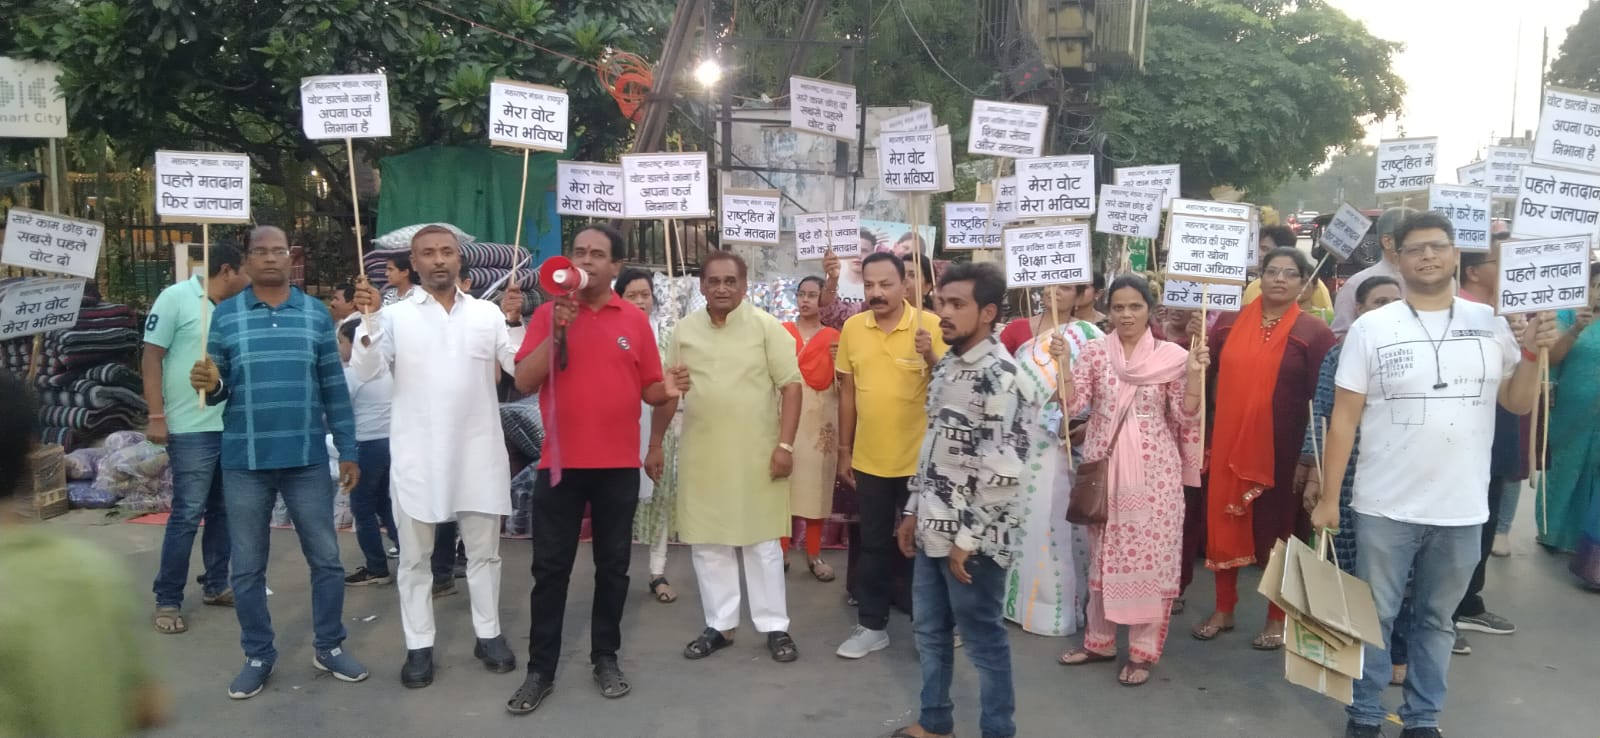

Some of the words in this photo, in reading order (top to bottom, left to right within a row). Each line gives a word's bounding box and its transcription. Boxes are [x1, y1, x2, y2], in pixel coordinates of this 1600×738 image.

[307, 94, 323, 104] वोट
[351, 94, 371, 103] जाना
[374, 91, 380, 102] है
[1546, 93, 1562, 107] वोट
[34, 113, 61, 125] City
[319, 110, 348, 118] अपना
[502, 101, 527, 120] मेरा
[530, 105, 555, 123] वोट
[324, 121, 358, 133] निभाना
[359, 119, 369, 133] है
[494, 119, 518, 138] मेरा
[522, 124, 564, 143] भविष्य
[807, 118, 824, 129] वोट
[1553, 119, 1581, 134] अपना
[889, 149, 905, 165] मेरा
[907, 148, 926, 165] वोट
[1552, 139, 1585, 158] निभाना
[1586, 144, 1596, 161] है
[1381, 155, 1422, 172] राष्ट्रहित
[1425, 153, 1435, 167] में
[161, 171, 194, 188] पहले
[198, 175, 243, 190] मतदान
[694, 170, 701, 182] है
[885, 168, 901, 185] मेरा
[903, 169, 935, 184] भविष्य
[1029, 176, 1053, 192] मेरा
[1057, 173, 1081, 191] वोट
[1377, 174, 1398, 189] करें
[1399, 174, 1435, 188] मतदान
[569, 179, 590, 194] मेरा
[593, 180, 614, 196] वोट
[640, 187, 669, 198] अपना
[1525, 176, 1557, 195] पहले
[161, 192, 189, 208] फिर
[192, 197, 244, 211] जलपान
[561, 195, 583, 211] मेरा
[586, 197, 622, 213] भविष्य
[645, 199, 678, 212] निभाना
[680, 197, 688, 212] है
[1020, 196, 1046, 213] मेरा
[1048, 194, 1090, 211] भविष्य
[727, 209, 764, 224] राष्ट्रहित
[766, 210, 776, 223] में
[1456, 203, 1472, 219] करें
[1520, 198, 1548, 218] फिर
[1549, 206, 1599, 225] जलपान
[12, 214, 33, 225] सारे
[36, 219, 60, 230] काम
[86, 227, 98, 237] दो
[724, 224, 741, 237] करें
[744, 229, 776, 240] मतदान
[834, 228, 858, 238] जवान
[1112, 222, 1128, 233] वोट
[1129, 224, 1139, 235] दो
[17, 231, 53, 247] सबसे
[56, 238, 88, 252] पहले
[947, 232, 966, 244] करें
[1458, 229, 1487, 242] मतदान
[832, 244, 858, 253] मतदान
[29, 249, 54, 263] वोट
[56, 254, 71, 266] दो
[1018, 254, 1047, 268] शिक्षा
[1050, 251, 1075, 265] सेवा
[1013, 268, 1037, 283] और
[1040, 267, 1083, 281] मतदान
[1172, 261, 1202, 273] अपना
[1204, 261, 1245, 276] अधिकार
[1505, 262, 1537, 283] पहले
[1540, 262, 1583, 279] मतदान
[1166, 288, 1191, 303] करें
[1501, 289, 1529, 308] फिर
[1531, 284, 1555, 305] सारे
[1558, 286, 1586, 301] काम
[16, 301, 42, 316] मेरा
[45, 296, 71, 311] वोट
[2, 321, 29, 335] मेरा
[32, 312, 76, 329] भविष्य
[146, 313, 159, 332] 8
